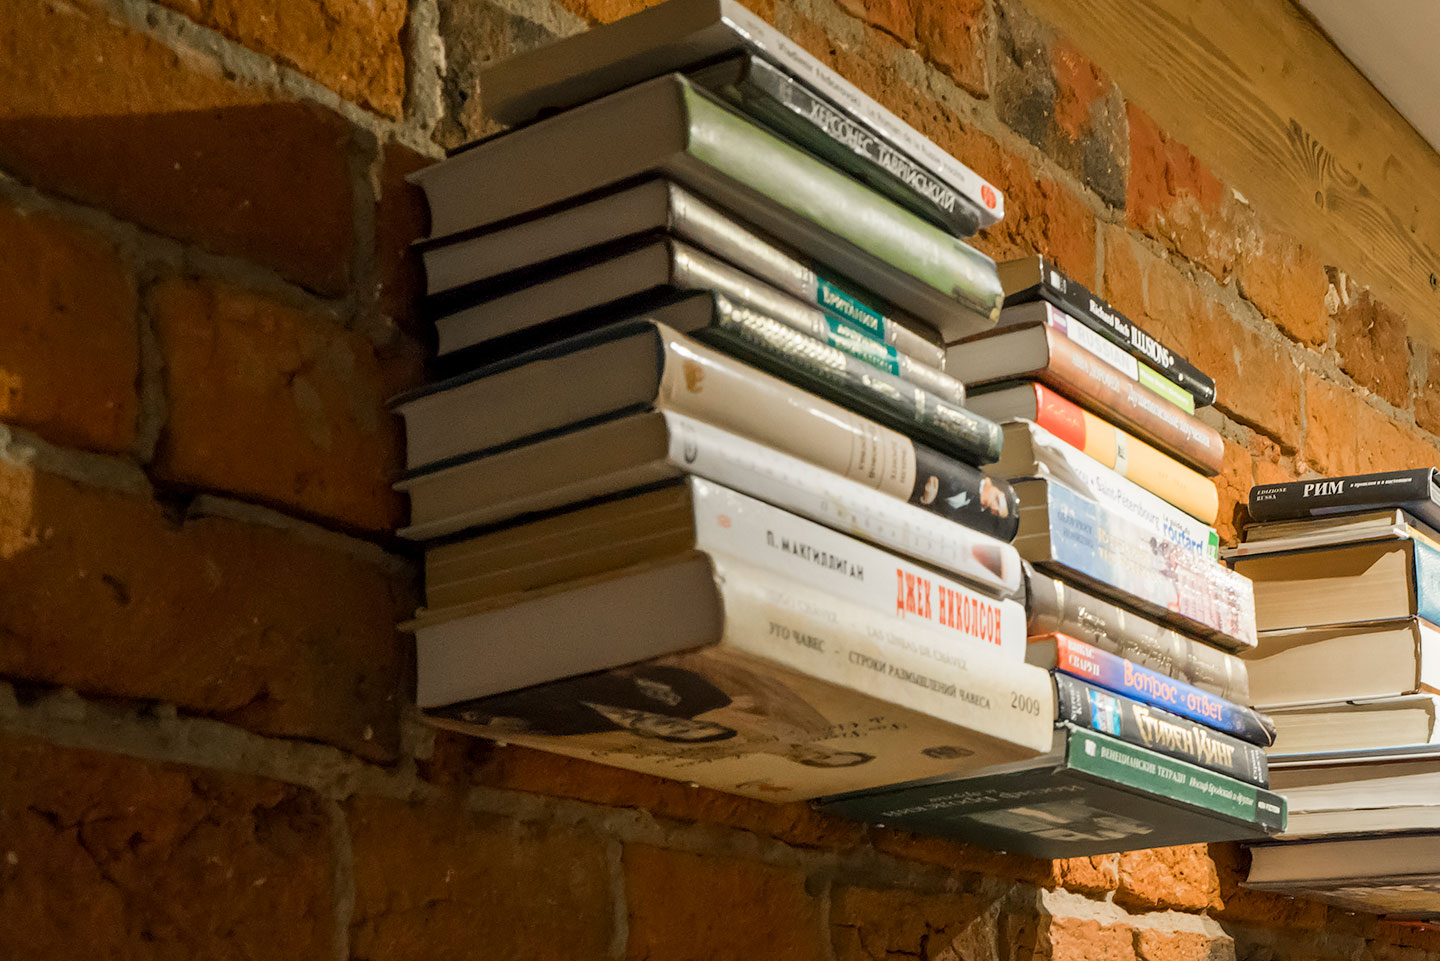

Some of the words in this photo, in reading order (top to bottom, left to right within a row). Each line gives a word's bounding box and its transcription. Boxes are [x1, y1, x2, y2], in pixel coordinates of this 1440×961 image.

[811, 100, 874, 158] ХЕРСОНЕС
[1130, 325, 1169, 369] ILLUSIONS
[1302, 480, 1345, 498] РИМ
[781, 536, 865, 582] МАКГИЛЛИГАН
[896, 568, 932, 620] ДЖЕК
[938, 585, 1002, 647] НИКОЛСОН
[792, 628, 827, 653] ЧАВЕС
[848, 650, 887, 675] СТРОКИ
[888, 662, 956, 700] РАЗМЫШЛЕНИЙ
[958, 688, 990, 711] ЧАВЕСА
[1123, 659, 1178, 704] Вопрос
[1187, 692, 1223, 722] ответ
[1010, 691, 1041, 717] 2009
[1132, 704, 1194, 755] СТИВЕН
[1192, 726, 1235, 768] КИНГ
